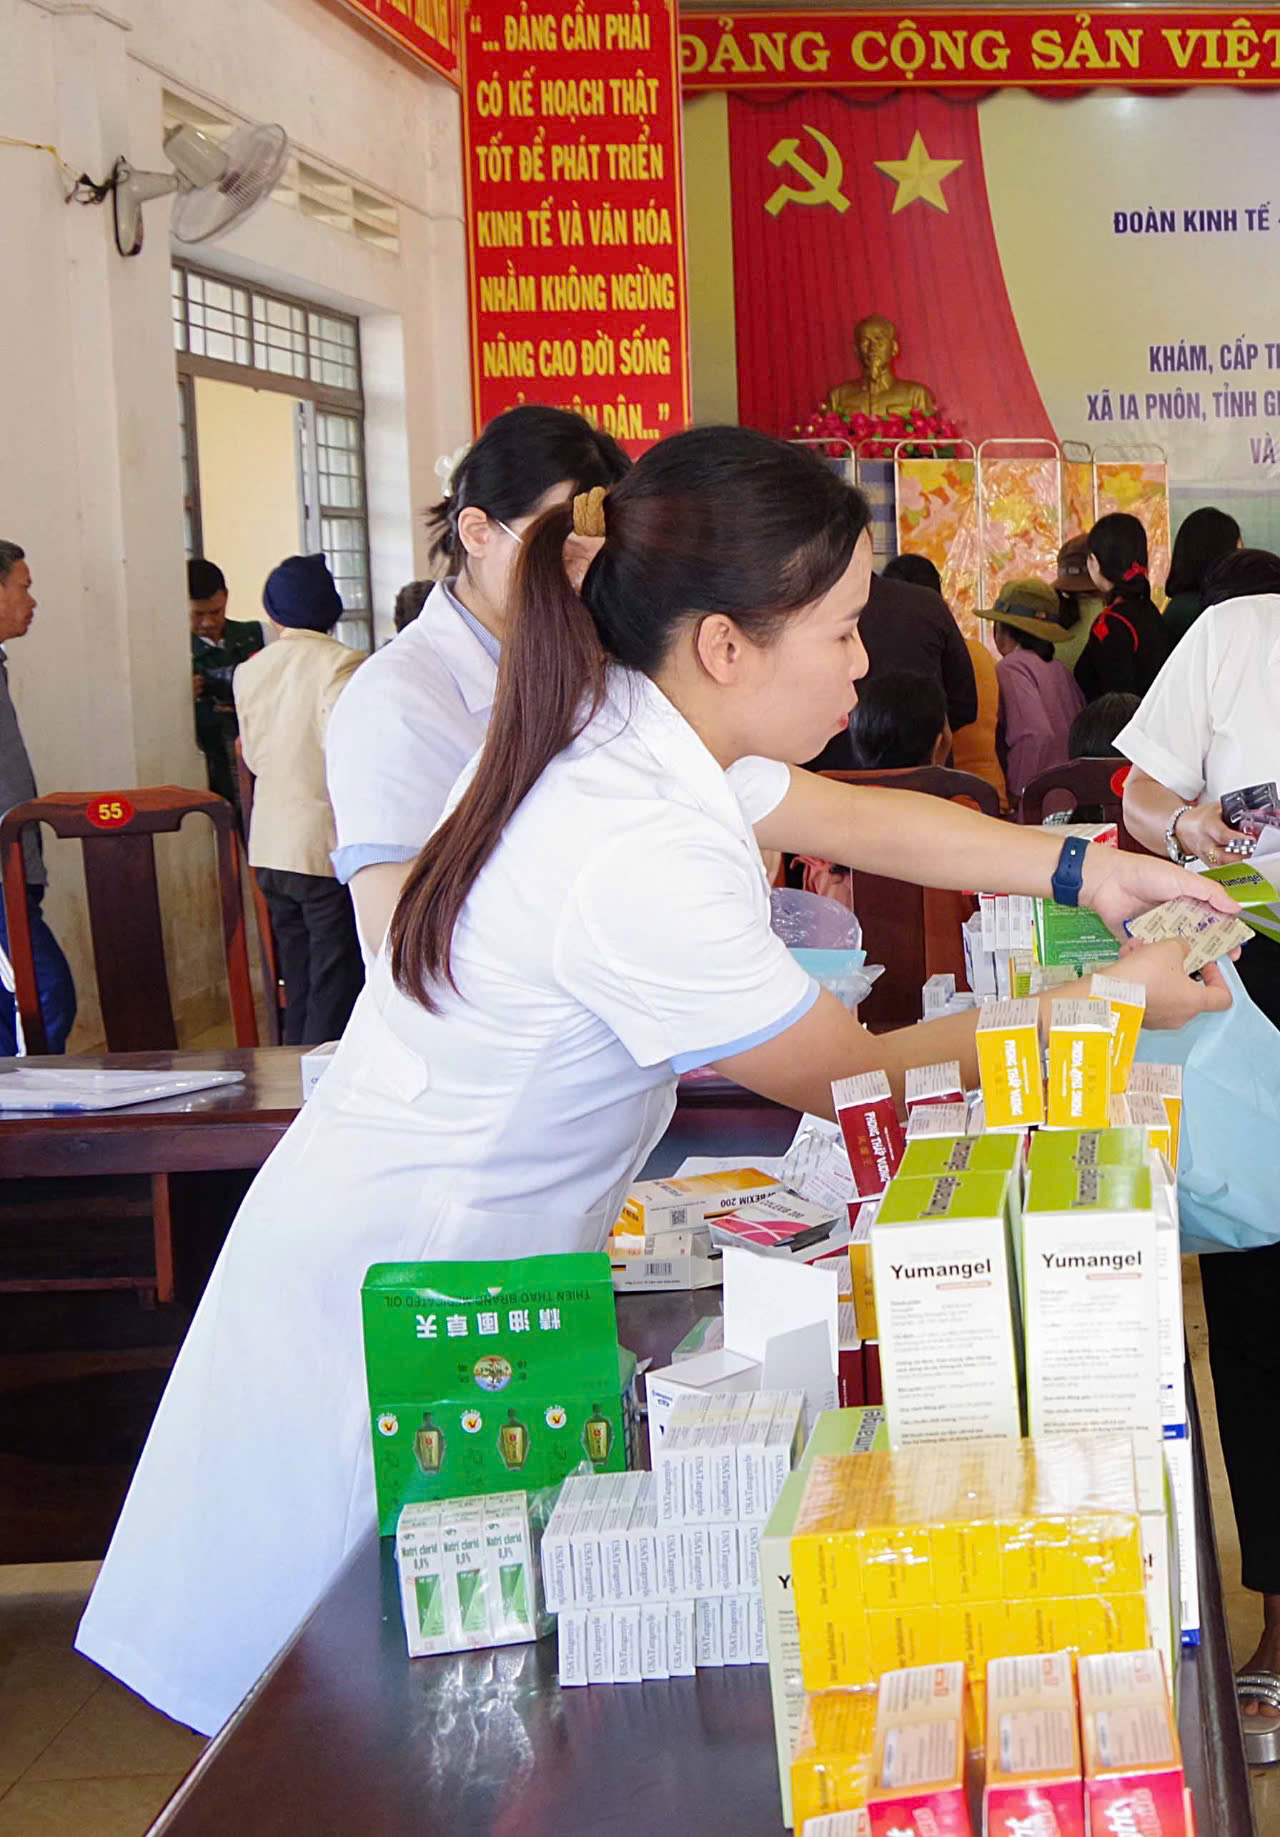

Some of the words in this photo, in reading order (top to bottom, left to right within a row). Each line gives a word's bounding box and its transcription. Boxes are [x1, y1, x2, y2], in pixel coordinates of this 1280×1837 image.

[505, 1, 558, 51] ĐẢNG
[561, 0, 600, 51] CẦN
[605, 0, 650, 50] PHẢI
[682, 17, 830, 72] ĐẢNG
[851, 20, 1011, 80] CỘNG
[1032, 14, 1142, 71] SẢN
[476, 70, 503, 118] CÓ
[508, 65, 536, 117] KẾ
[541, 80, 604, 124] HOẠCH
[609, 68, 659, 123] THẬT
[475, 130, 513, 183] TỐT
[519, 125, 546, 182] ĐỂ
[551, 134, 600, 182] PHÁT
[605, 124, 664, 181] TRIỂN
[477, 211, 523, 247] KINH
[527, 195, 553, 247] TẾ
[558, 200, 584, 246] VÀ
[588, 201, 628, 245] VĂN
[632, 198, 673, 245] HÓA
[1113, 204, 1176, 234] ĐOÀN
[1183, 208, 1238, 232] KINH
[1245, 200, 1270, 231] TẾ
[480, 258, 536, 312] NHẰM
[541, 265, 607, 312] KHÔNG
[611, 264, 676, 311] NGỪNG
[483, 332, 535, 377] NÂNG
[539, 340, 577, 377] CAO
[581, 329, 615, 376] ĐỜI
[620, 324, 672, 376] SỐNG
[1149, 338, 1213, 374] KHÁM,
[1220, 334, 1259, 369] CẤP
[1087, 387, 1113, 421] XÃ
[1119, 394, 1139, 421] IA
[1145, 385, 1207, 422] PNÔN,
[1212, 381, 1258, 419] TỈNH
[1250, 432, 1276, 465] VÀ
[98, 802, 123, 820] 55
[890, 1259, 992, 1280] Yumangel
[1041, 1251, 1142, 1270] Yumangel
